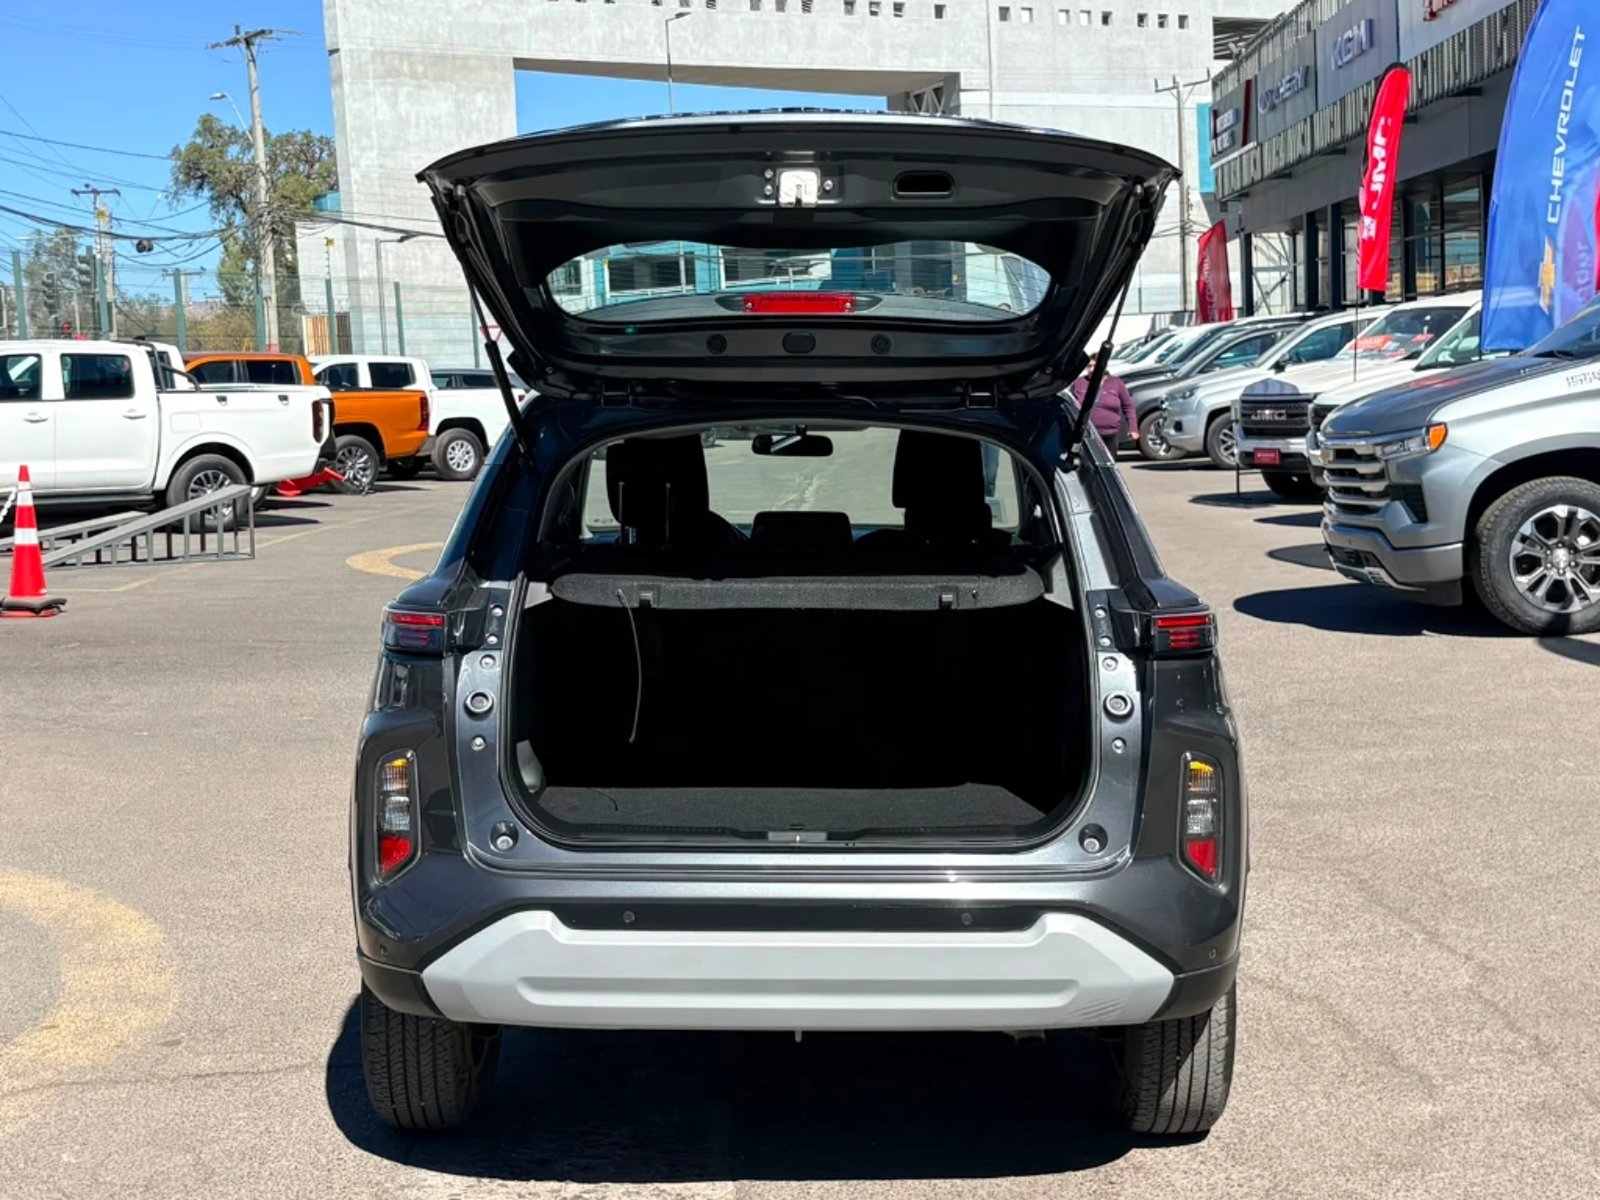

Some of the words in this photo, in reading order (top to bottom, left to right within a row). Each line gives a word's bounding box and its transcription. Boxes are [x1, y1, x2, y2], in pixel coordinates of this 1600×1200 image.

[1331, 19, 1372, 70] KGM
[1370, 115, 1391, 210] JMC
[1547, 25, 1585, 224] CHEVROLET
